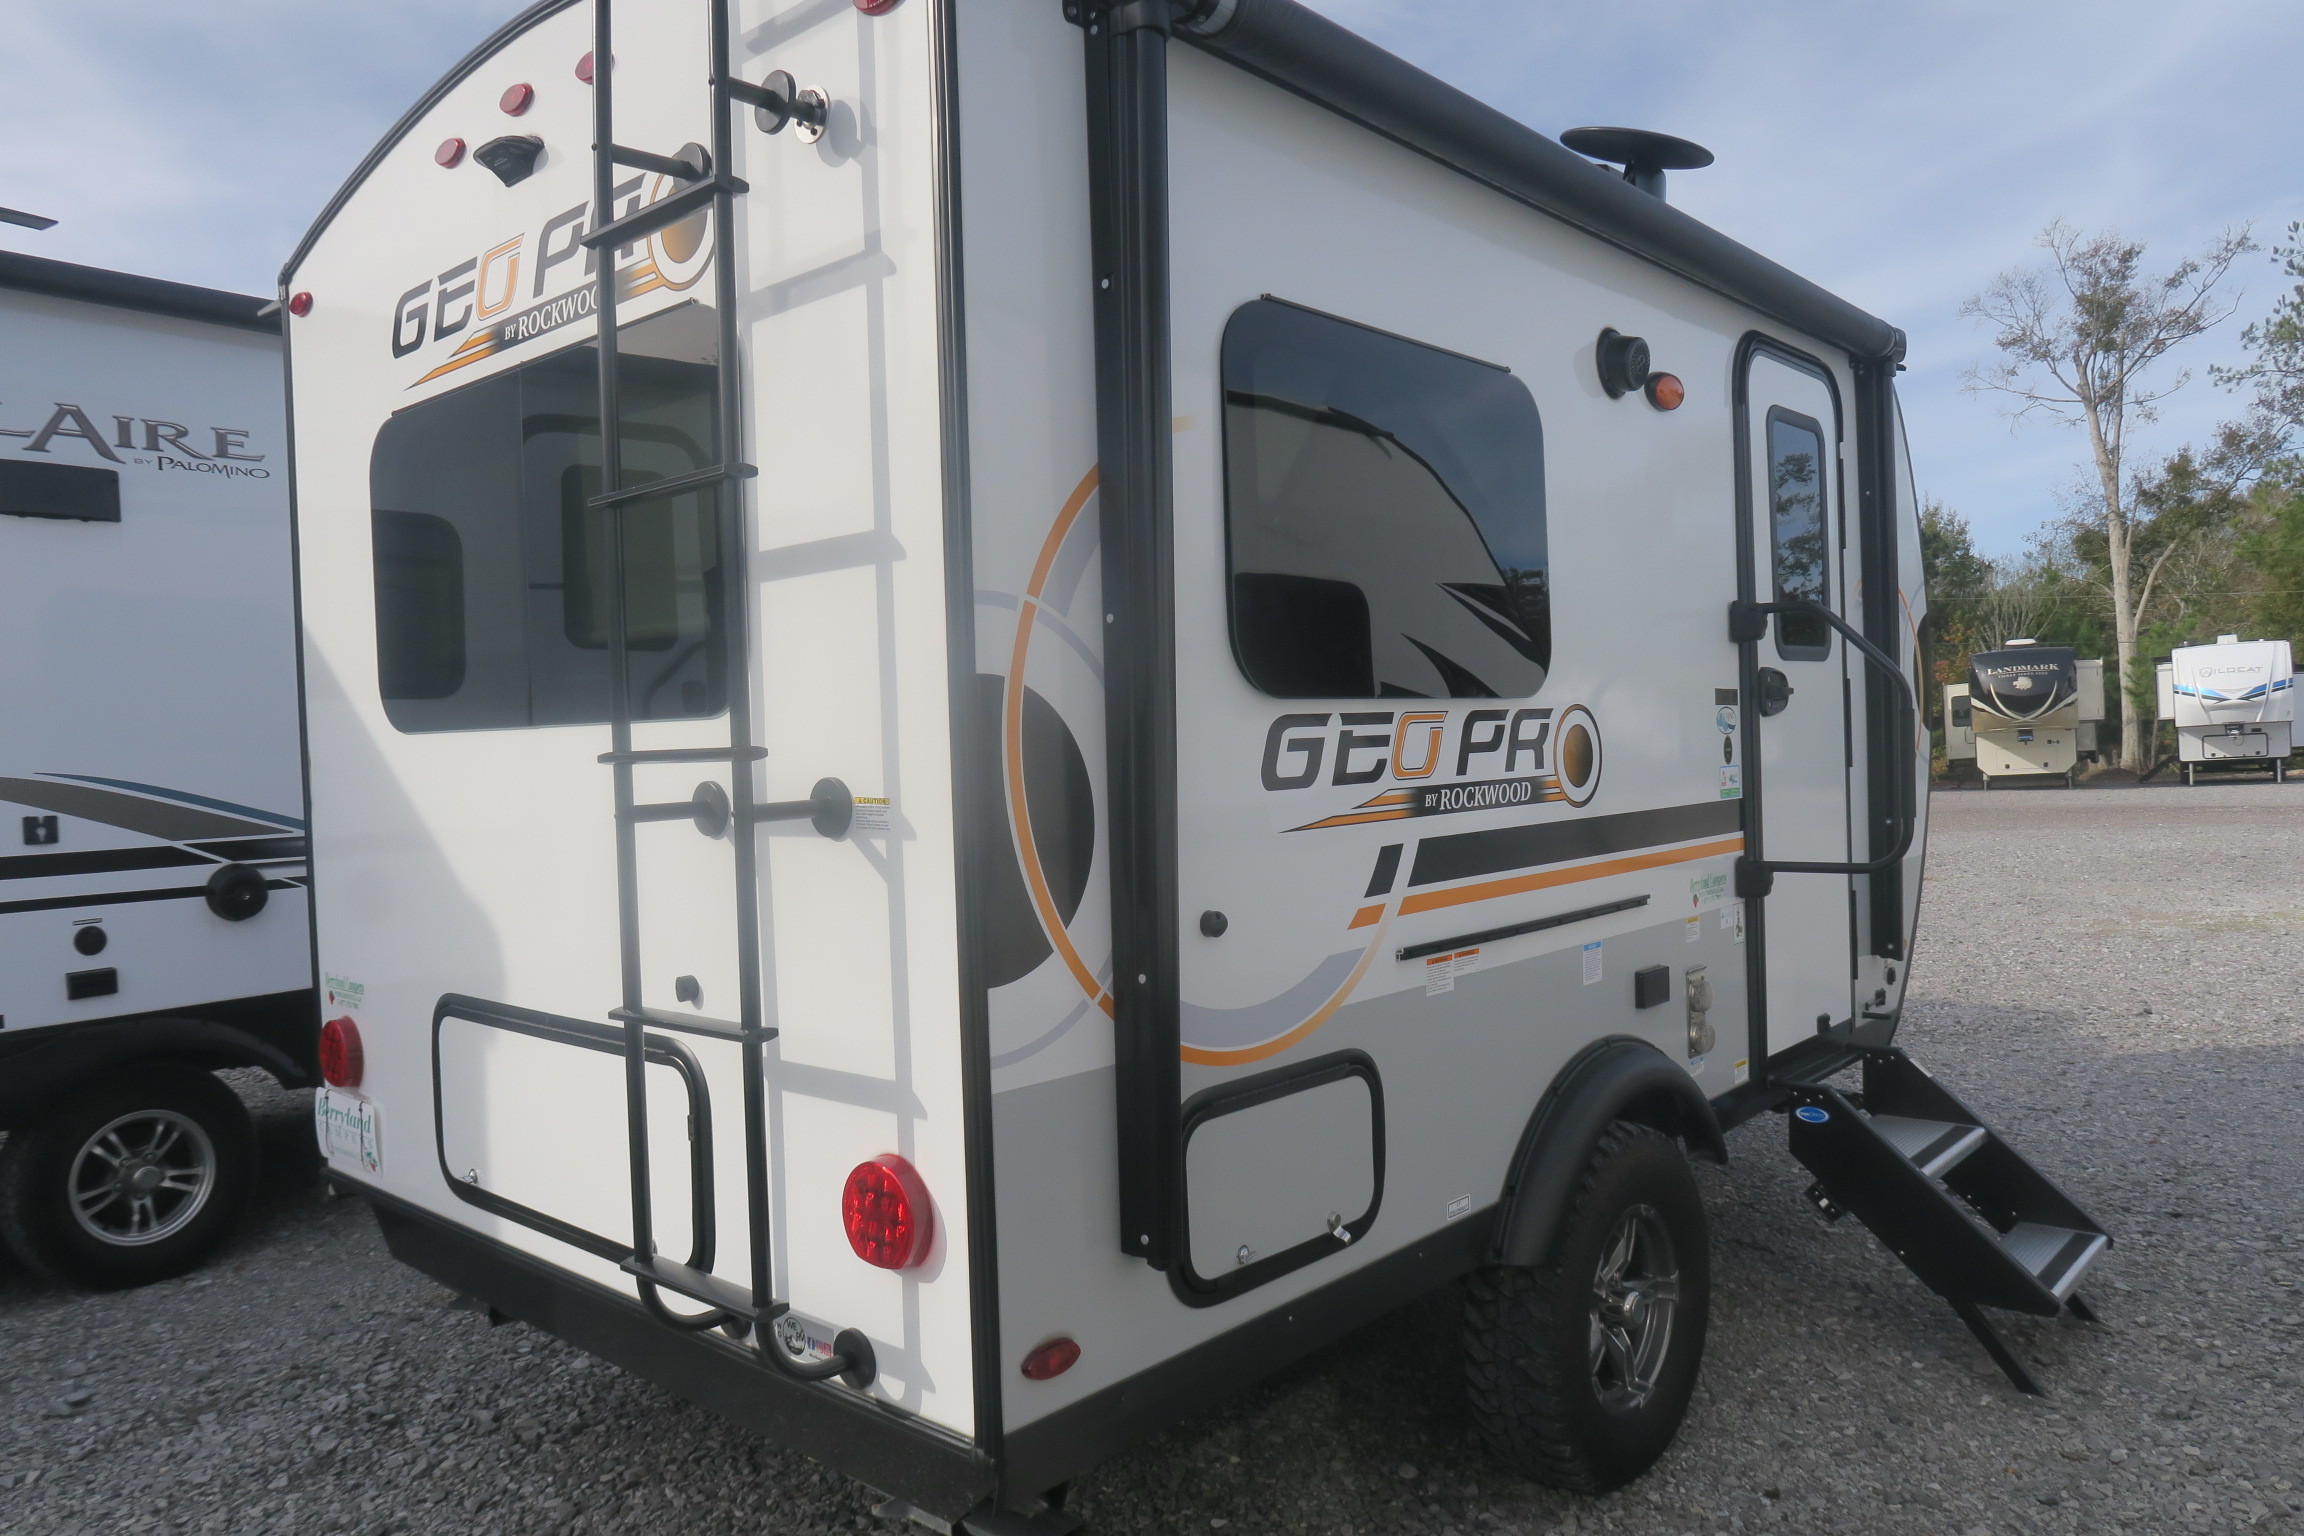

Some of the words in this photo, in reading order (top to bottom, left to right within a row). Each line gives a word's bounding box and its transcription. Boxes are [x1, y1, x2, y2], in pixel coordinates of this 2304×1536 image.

[391, 231, 525, 359] GEO
[504, 323, 516, 341] BY
[517, 285, 598, 340] ROCKWO
[134, 457, 152, 465] BY
[157, 455, 270, 479] PALOMINO
[1987, 663, 2059, 676] LANDMARK
[1260, 710, 1449, 792] GEO
[1455, 703, 1603, 808] PRO
[1425, 793, 1438, 808] BY
[1439, 781, 1532, 811] ROCKWOOD
[317, 1097, 372, 1133] Berryland
